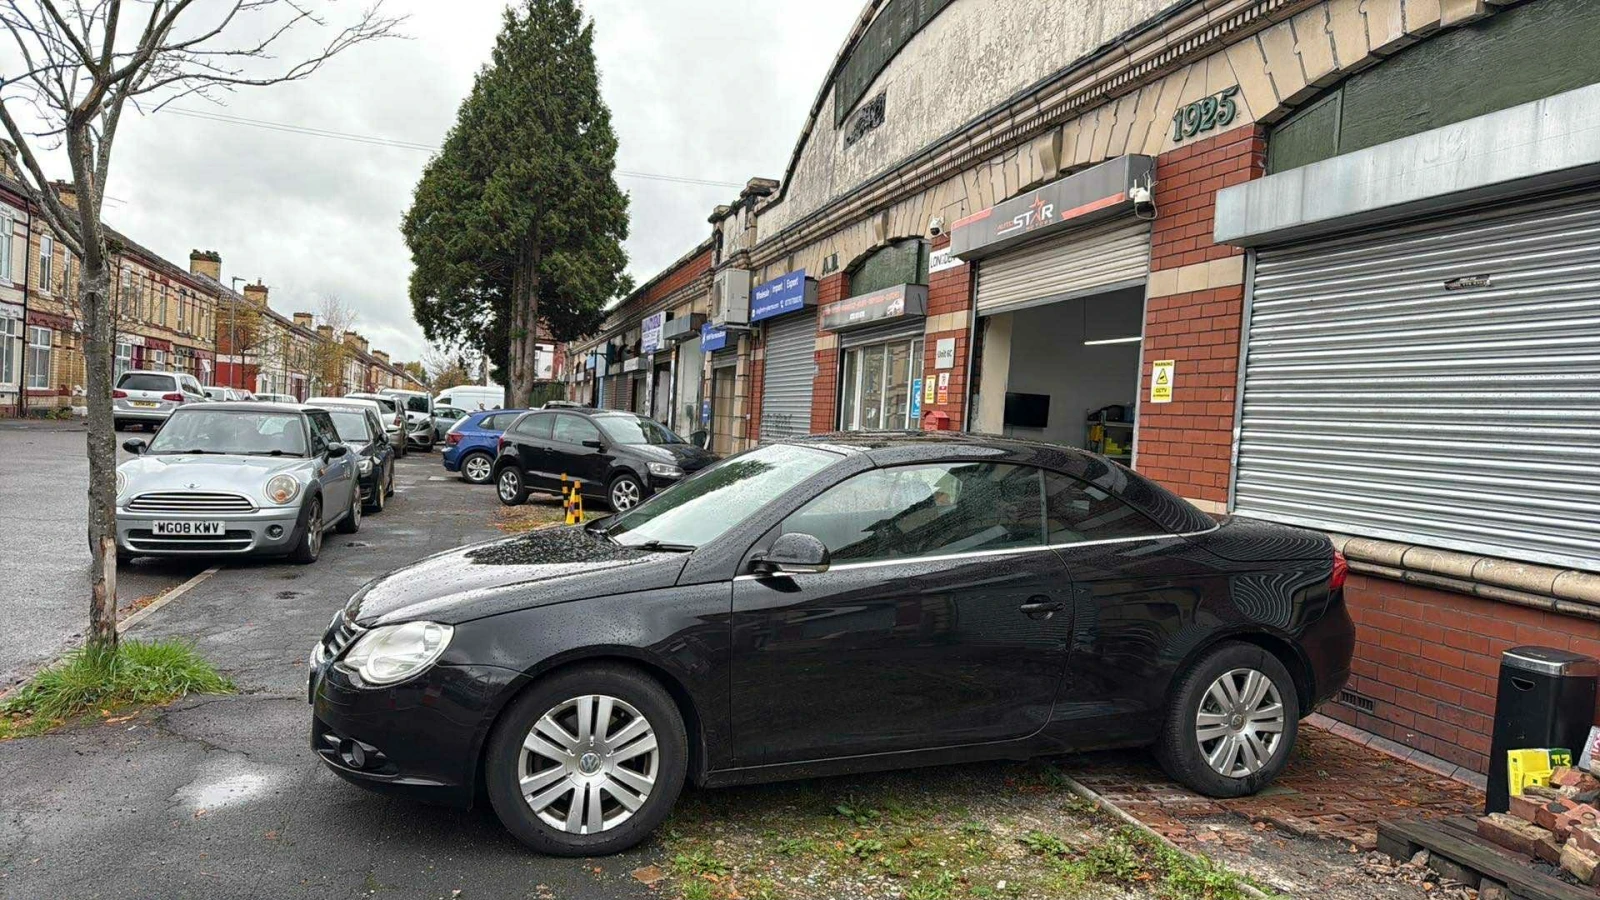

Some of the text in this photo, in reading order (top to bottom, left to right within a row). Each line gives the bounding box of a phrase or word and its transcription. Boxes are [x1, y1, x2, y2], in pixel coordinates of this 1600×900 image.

[1172, 83, 1240, 142] 1925
[157, 522, 220, 534] WG08 KWV
